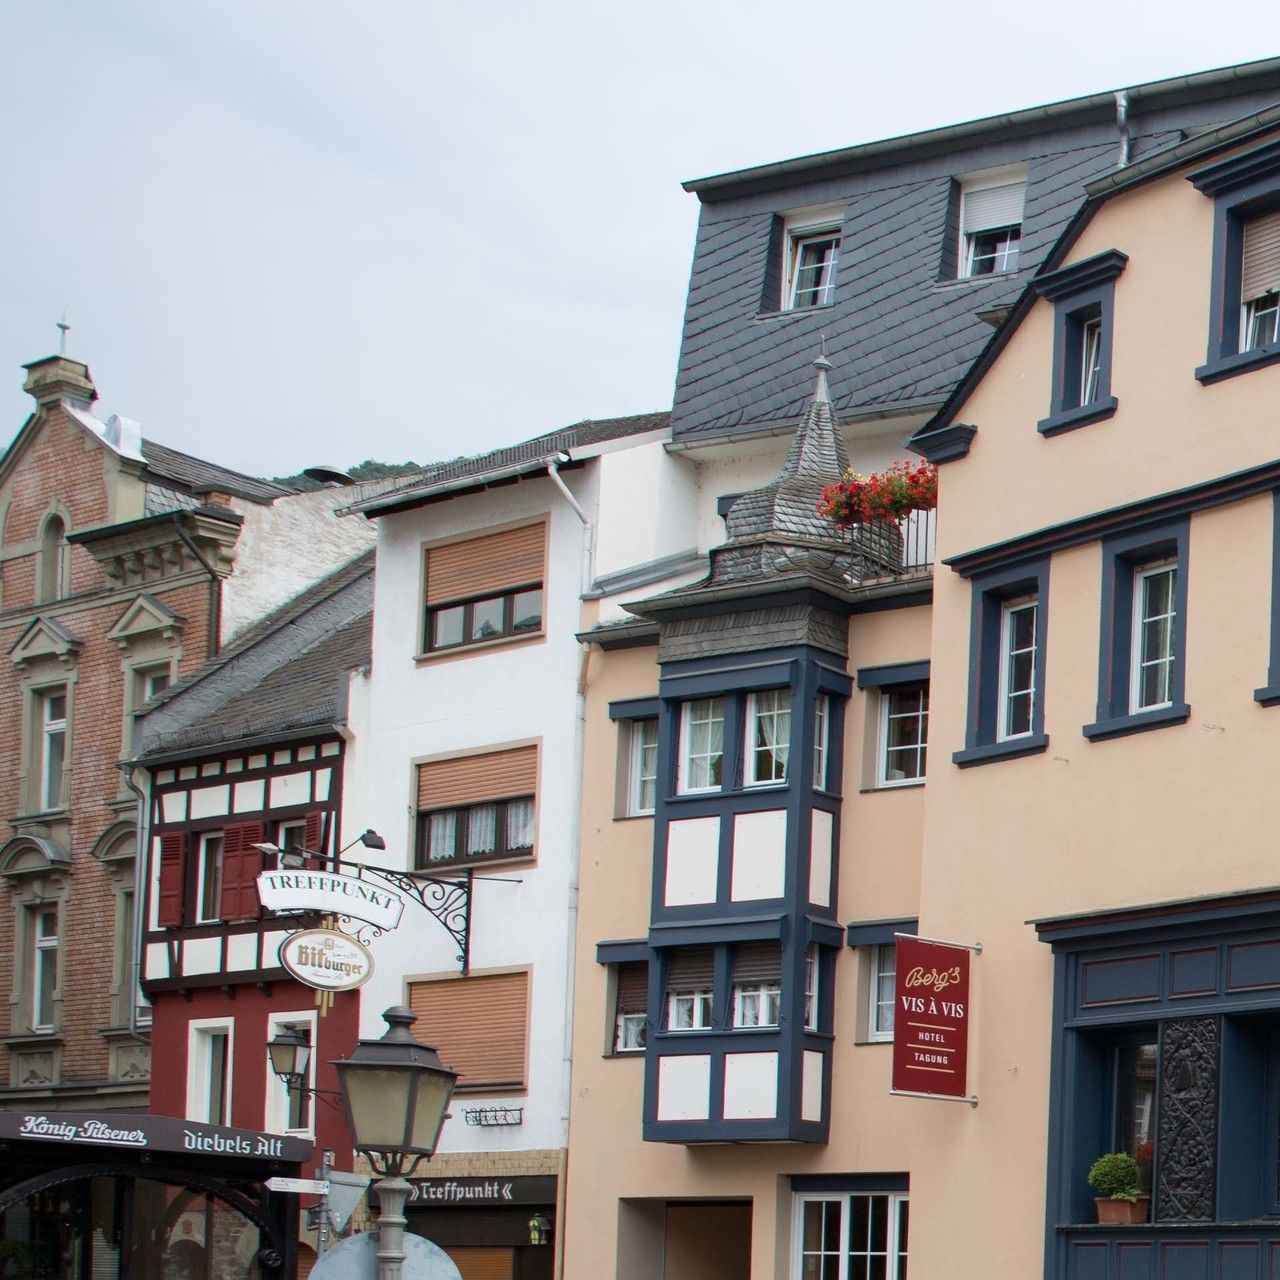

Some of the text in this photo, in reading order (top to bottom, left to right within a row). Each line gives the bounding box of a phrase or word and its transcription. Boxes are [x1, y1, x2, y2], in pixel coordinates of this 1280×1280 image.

[266, 875, 396, 910] TREFFPUNKT
[295, 944, 364, 978] Bitburger
[905, 966, 961, 993] Berg's
[901, 995, 965, 1018] VIS À VIS
[918, 1031, 945, 1043] HOTEL
[914, 1052, 949, 1065] TAGUNG
[20, 1115, 147, 1145] König-Pilsener
[254, 1136, 283, 1157] Alt
